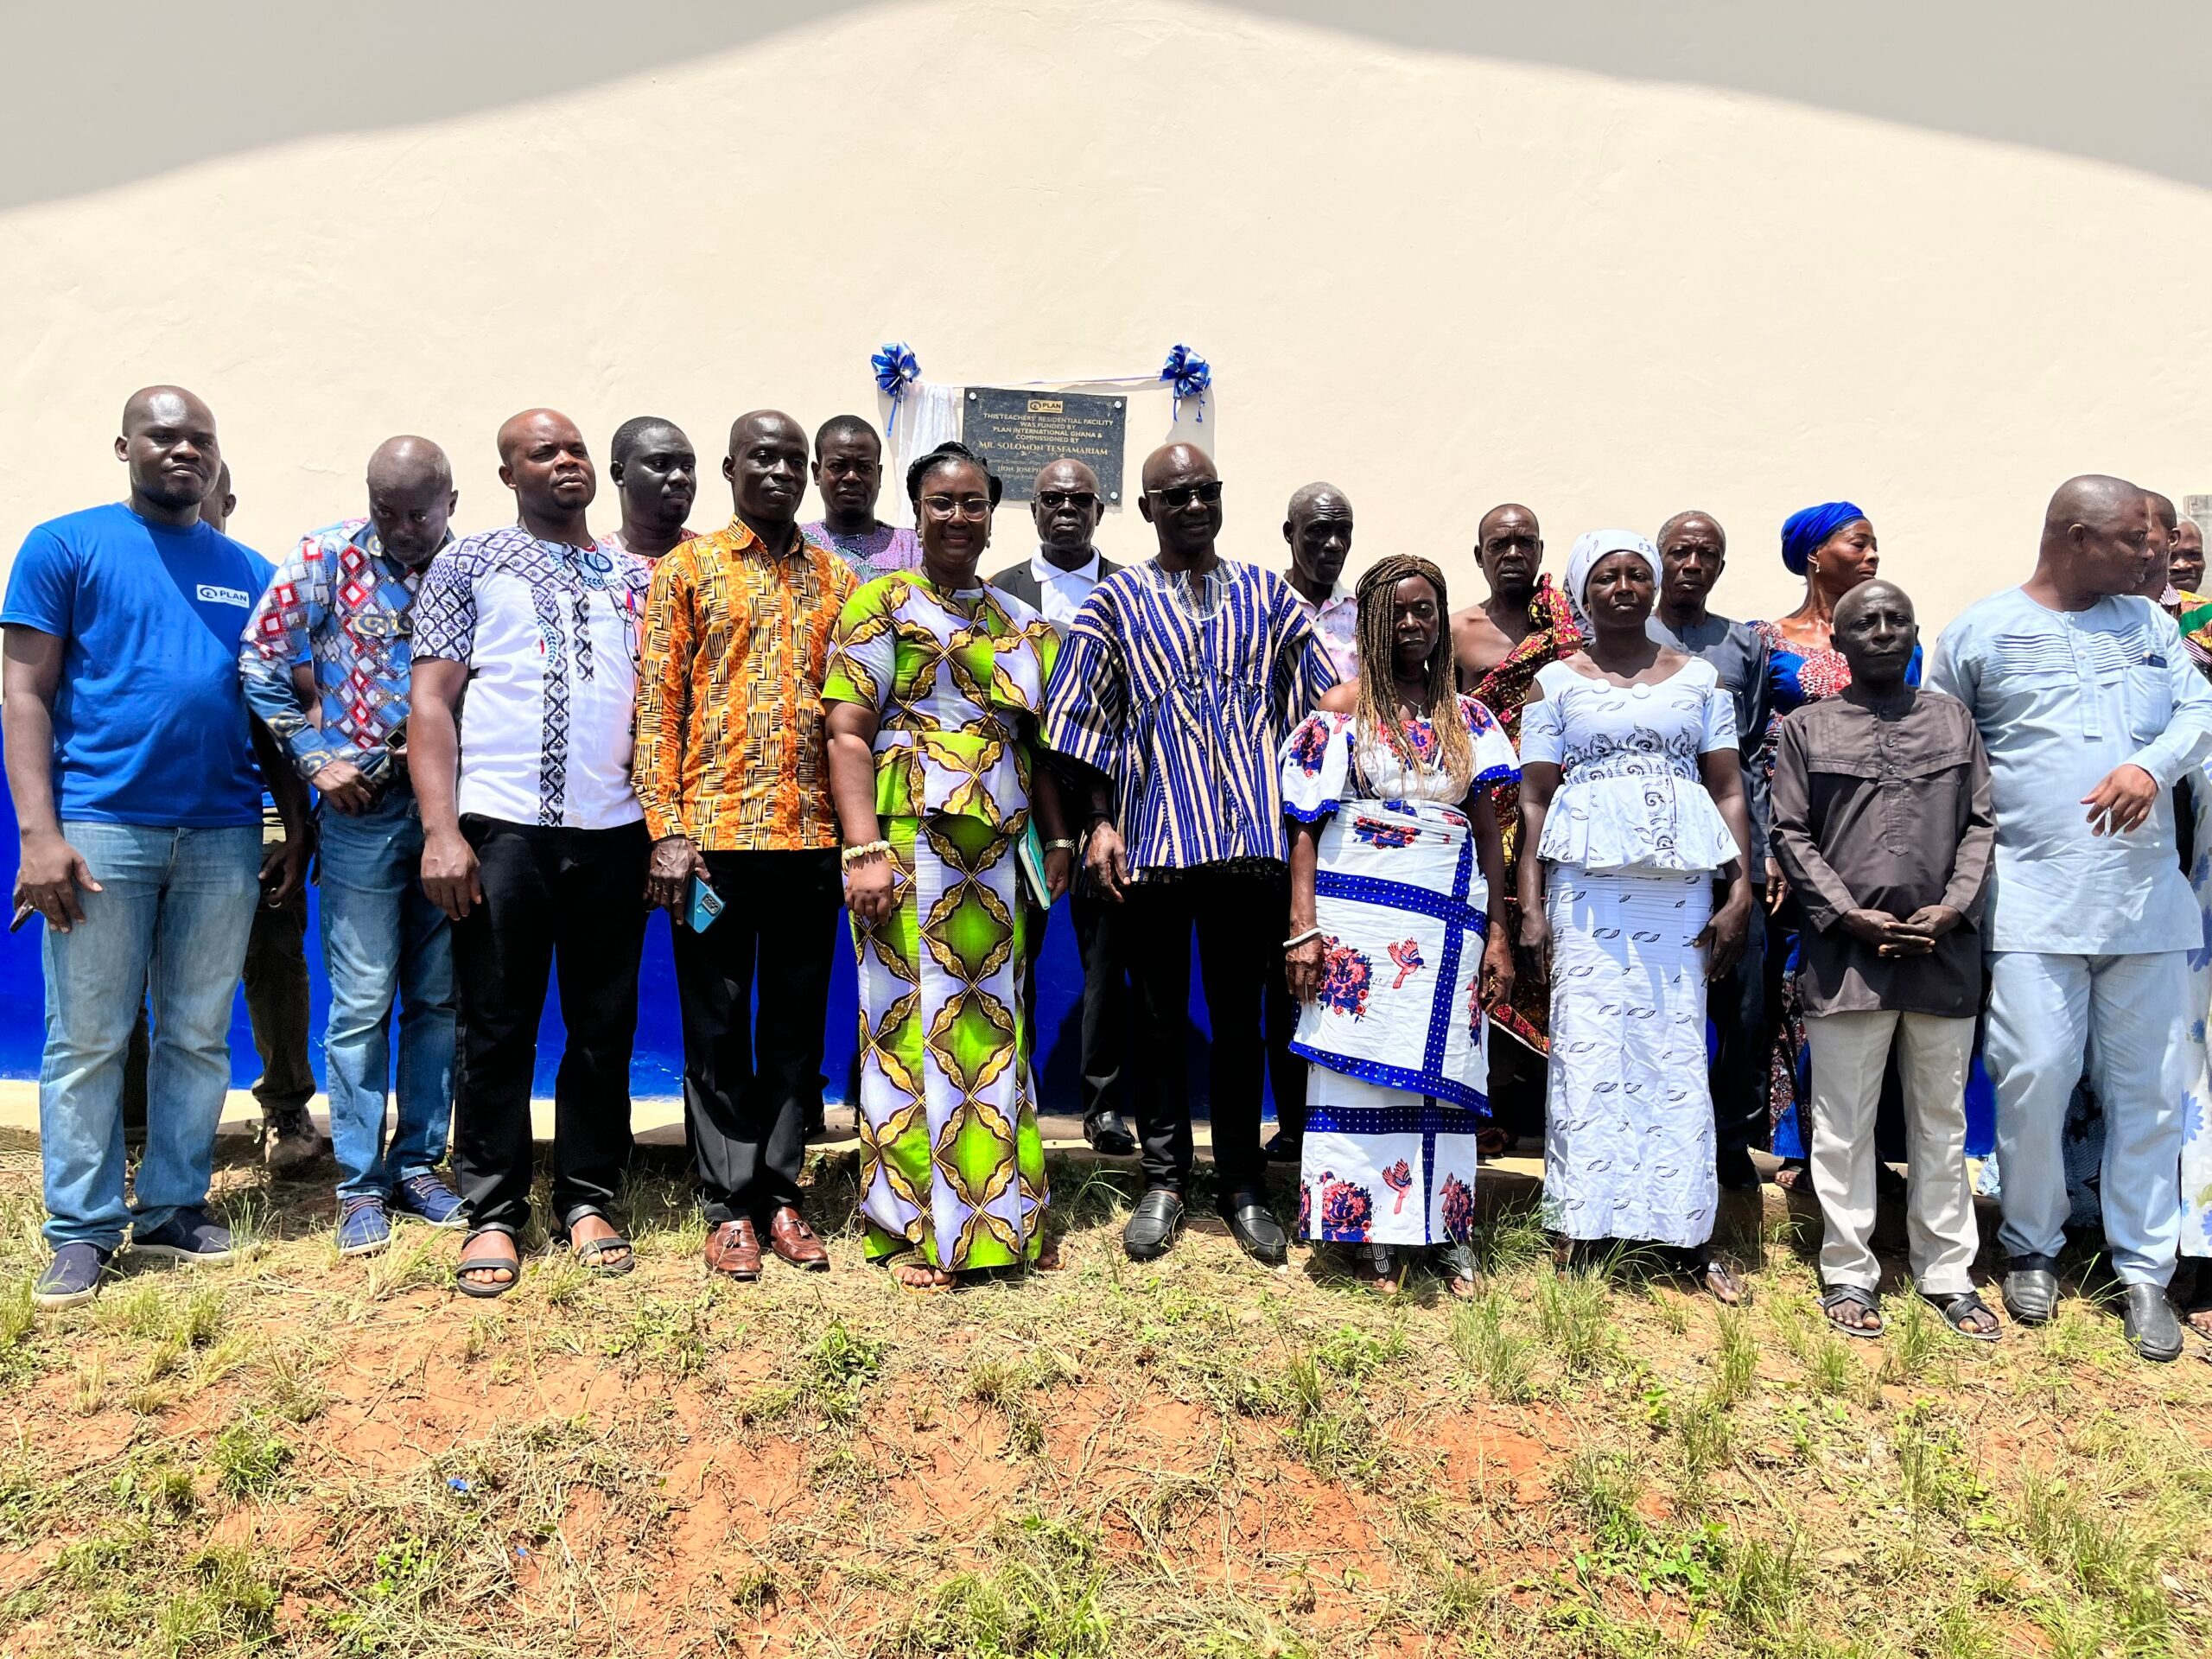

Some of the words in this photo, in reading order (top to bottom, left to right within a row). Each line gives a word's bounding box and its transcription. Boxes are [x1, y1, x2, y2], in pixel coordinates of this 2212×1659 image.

[1038, 416, 1081, 424] RESIDENTIAL
[1013, 428, 1069, 436] INTERNATIONAL
[1015, 434, 1069, 443] COMMISSIONED
[997, 442, 1044, 451] SOLOMON
[1046, 444, 1108, 455] TESFAMARIAM
[219, 590, 247, 602] PLAN
